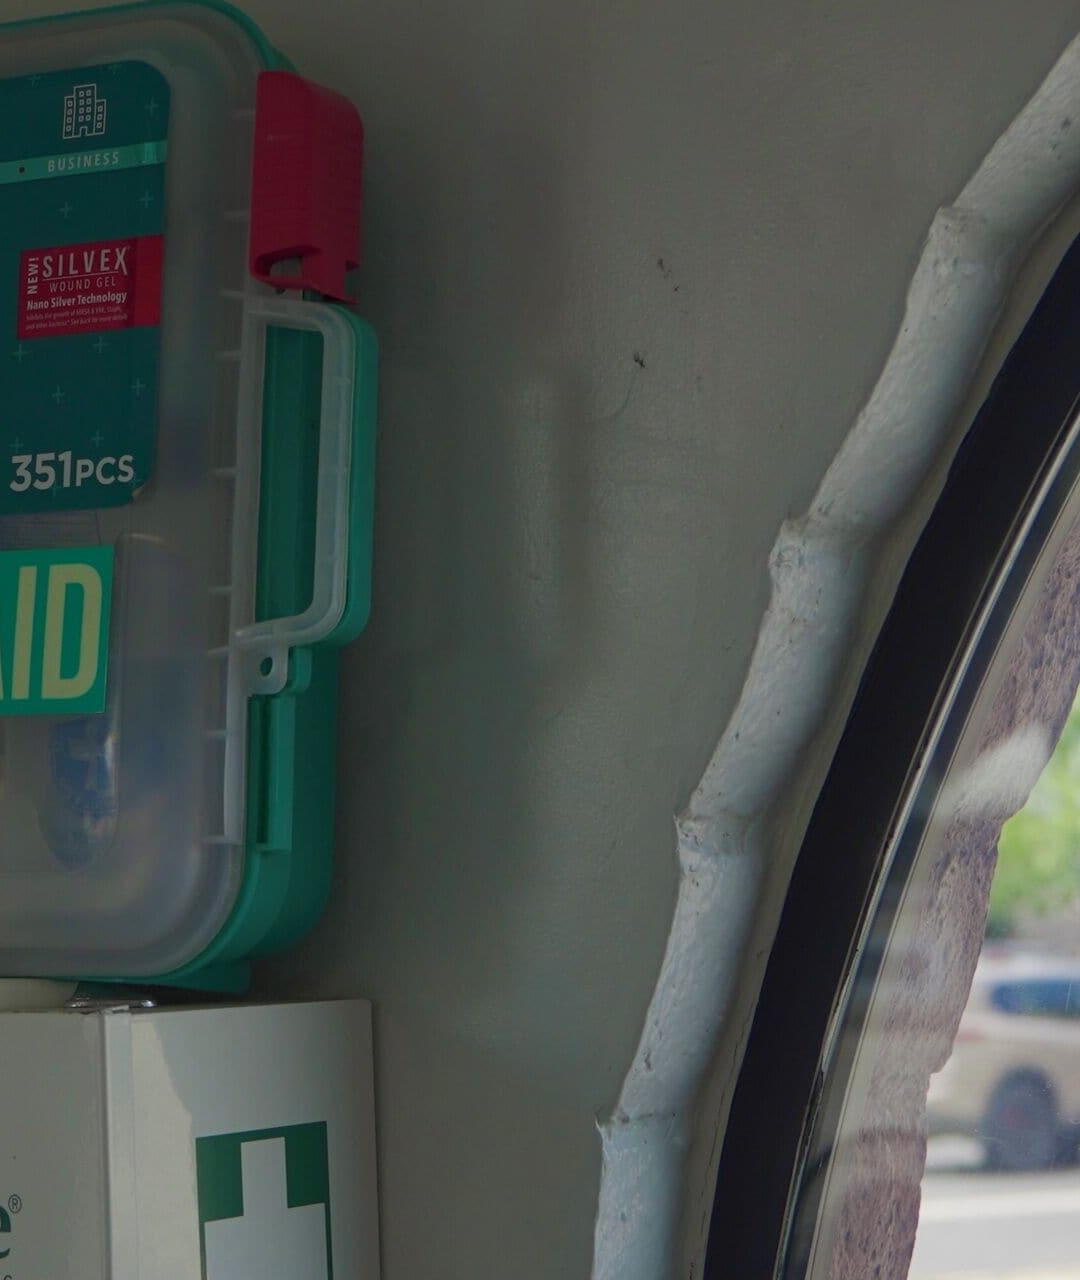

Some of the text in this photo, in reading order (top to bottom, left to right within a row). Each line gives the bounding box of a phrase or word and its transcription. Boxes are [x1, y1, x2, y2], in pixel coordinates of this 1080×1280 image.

[47, 152, 120, 174] BUSINESS
[42, 246, 128, 278] SILVEX
[27, 256, 39, 295] NEW!
[50, 276, 117, 293] WOUND GEL
[26, 292, 128, 311] Nano Silver Technology
